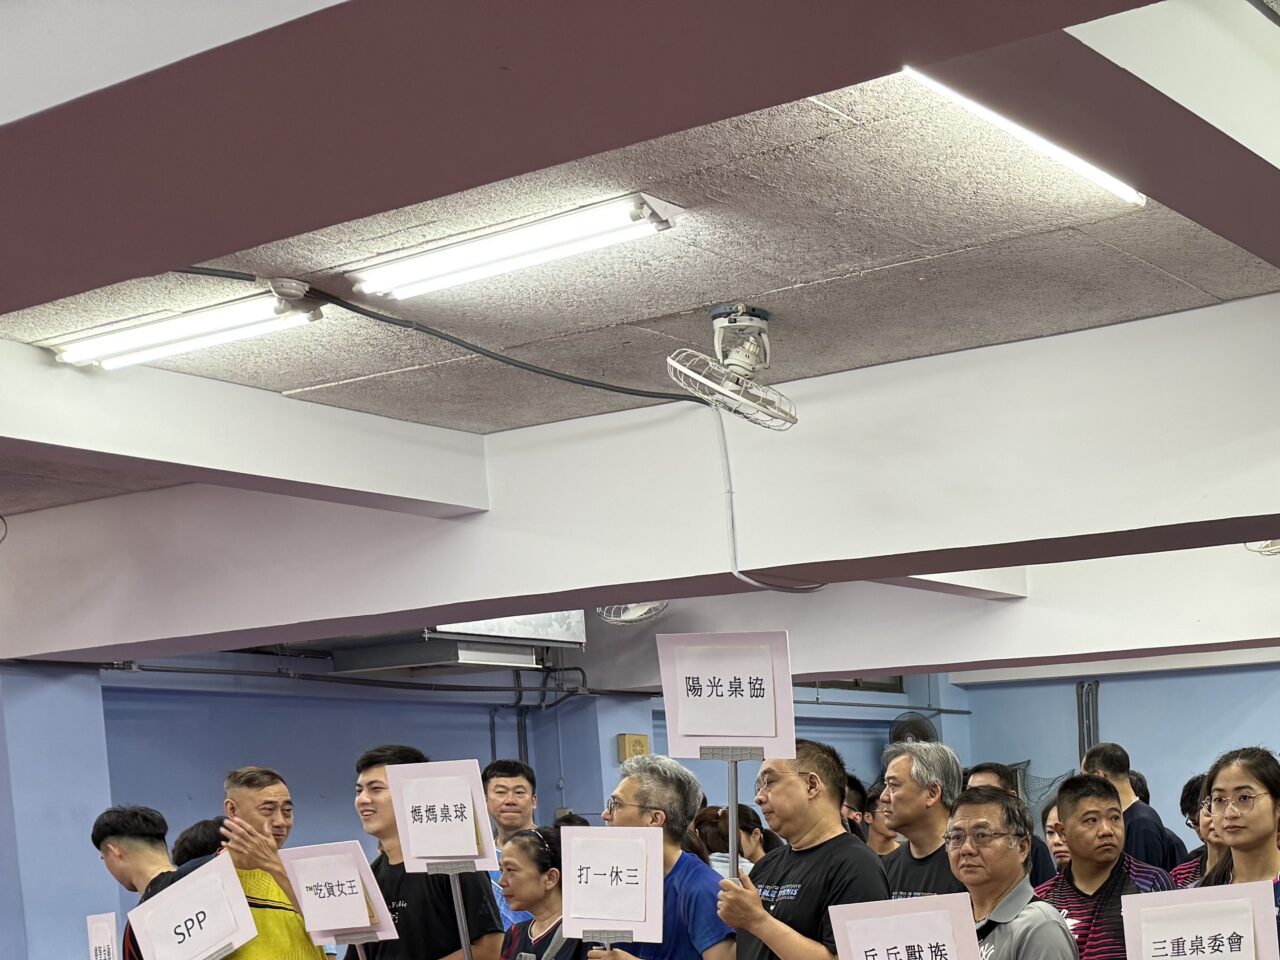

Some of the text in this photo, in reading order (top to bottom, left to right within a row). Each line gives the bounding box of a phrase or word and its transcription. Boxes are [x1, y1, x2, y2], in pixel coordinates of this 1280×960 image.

[685, 676, 765, 698] 陽光桌協
[410, 803, 468, 824] 媽媽桌球
[577, 865, 639, 886] 打一休三
[173, 910, 207, 944] SPP
[1151, 931, 1244, 958] 三重桌委會
